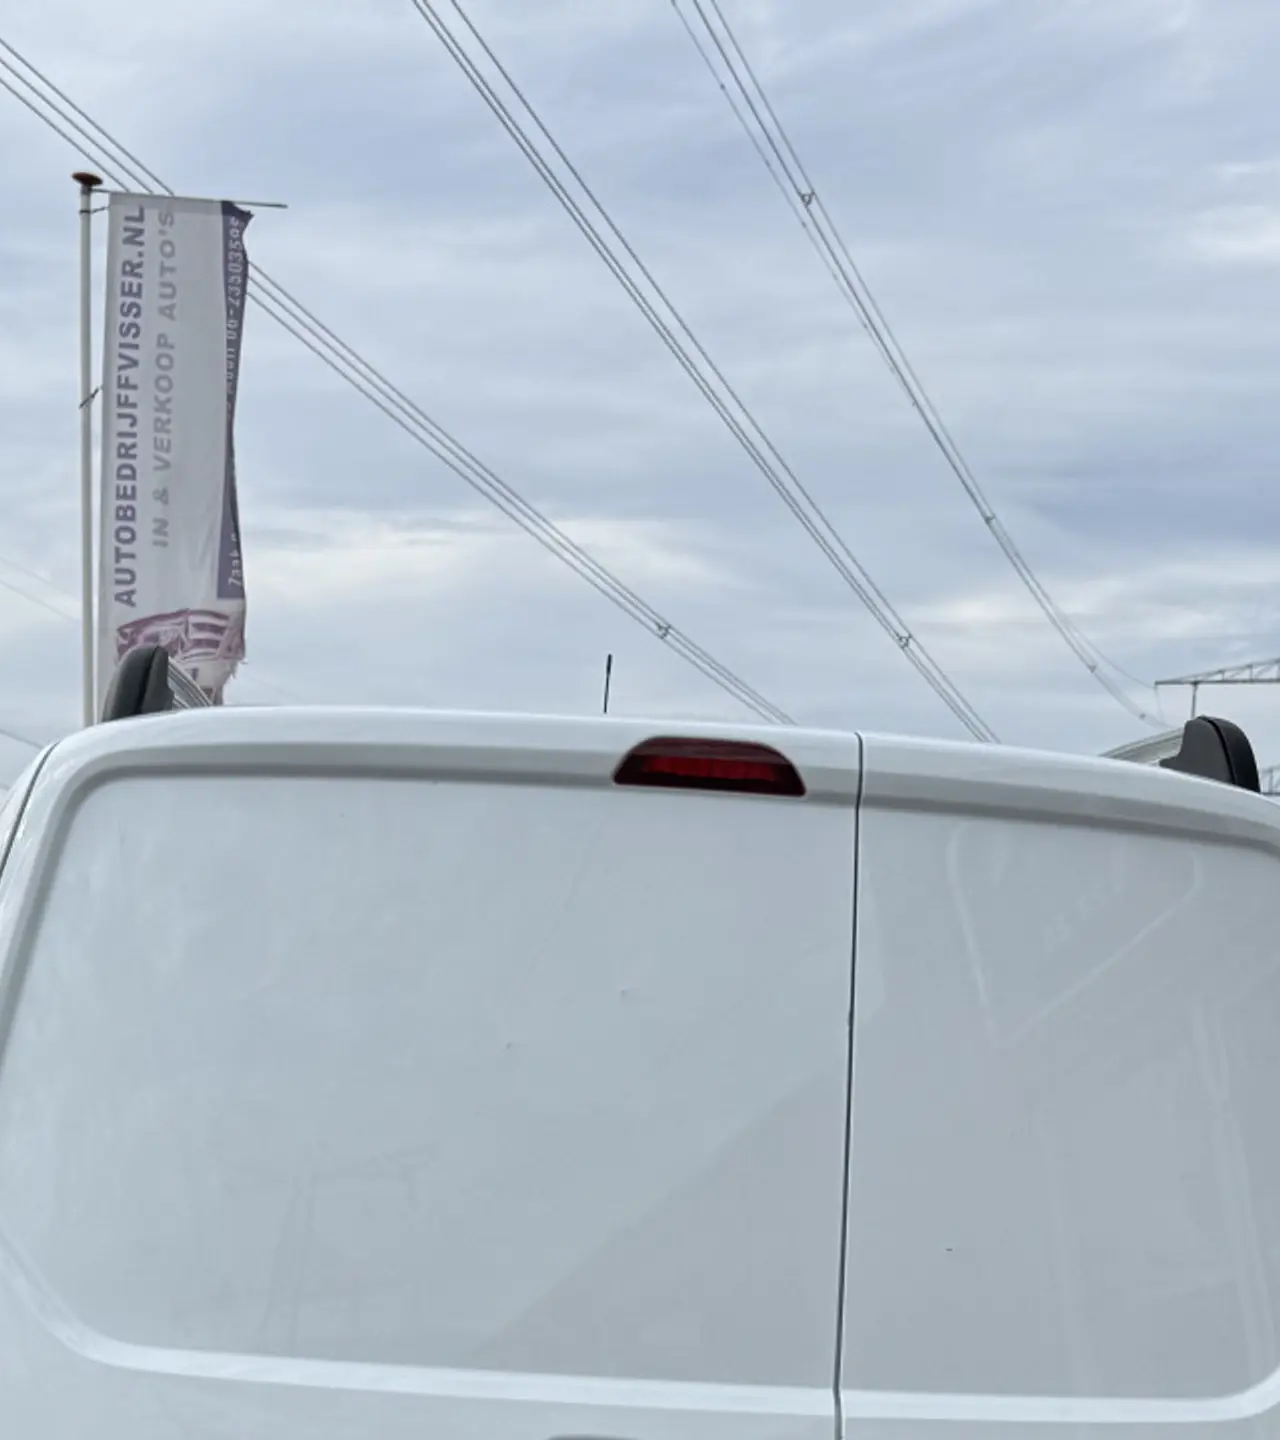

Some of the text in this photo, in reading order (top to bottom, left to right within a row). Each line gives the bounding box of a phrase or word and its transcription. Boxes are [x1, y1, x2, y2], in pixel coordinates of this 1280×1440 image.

[114, 204, 145, 608] AUTOBEDRIJFFVISSER.NL
[152, 209, 178, 548] IN & VERKOOP AUTO'S
